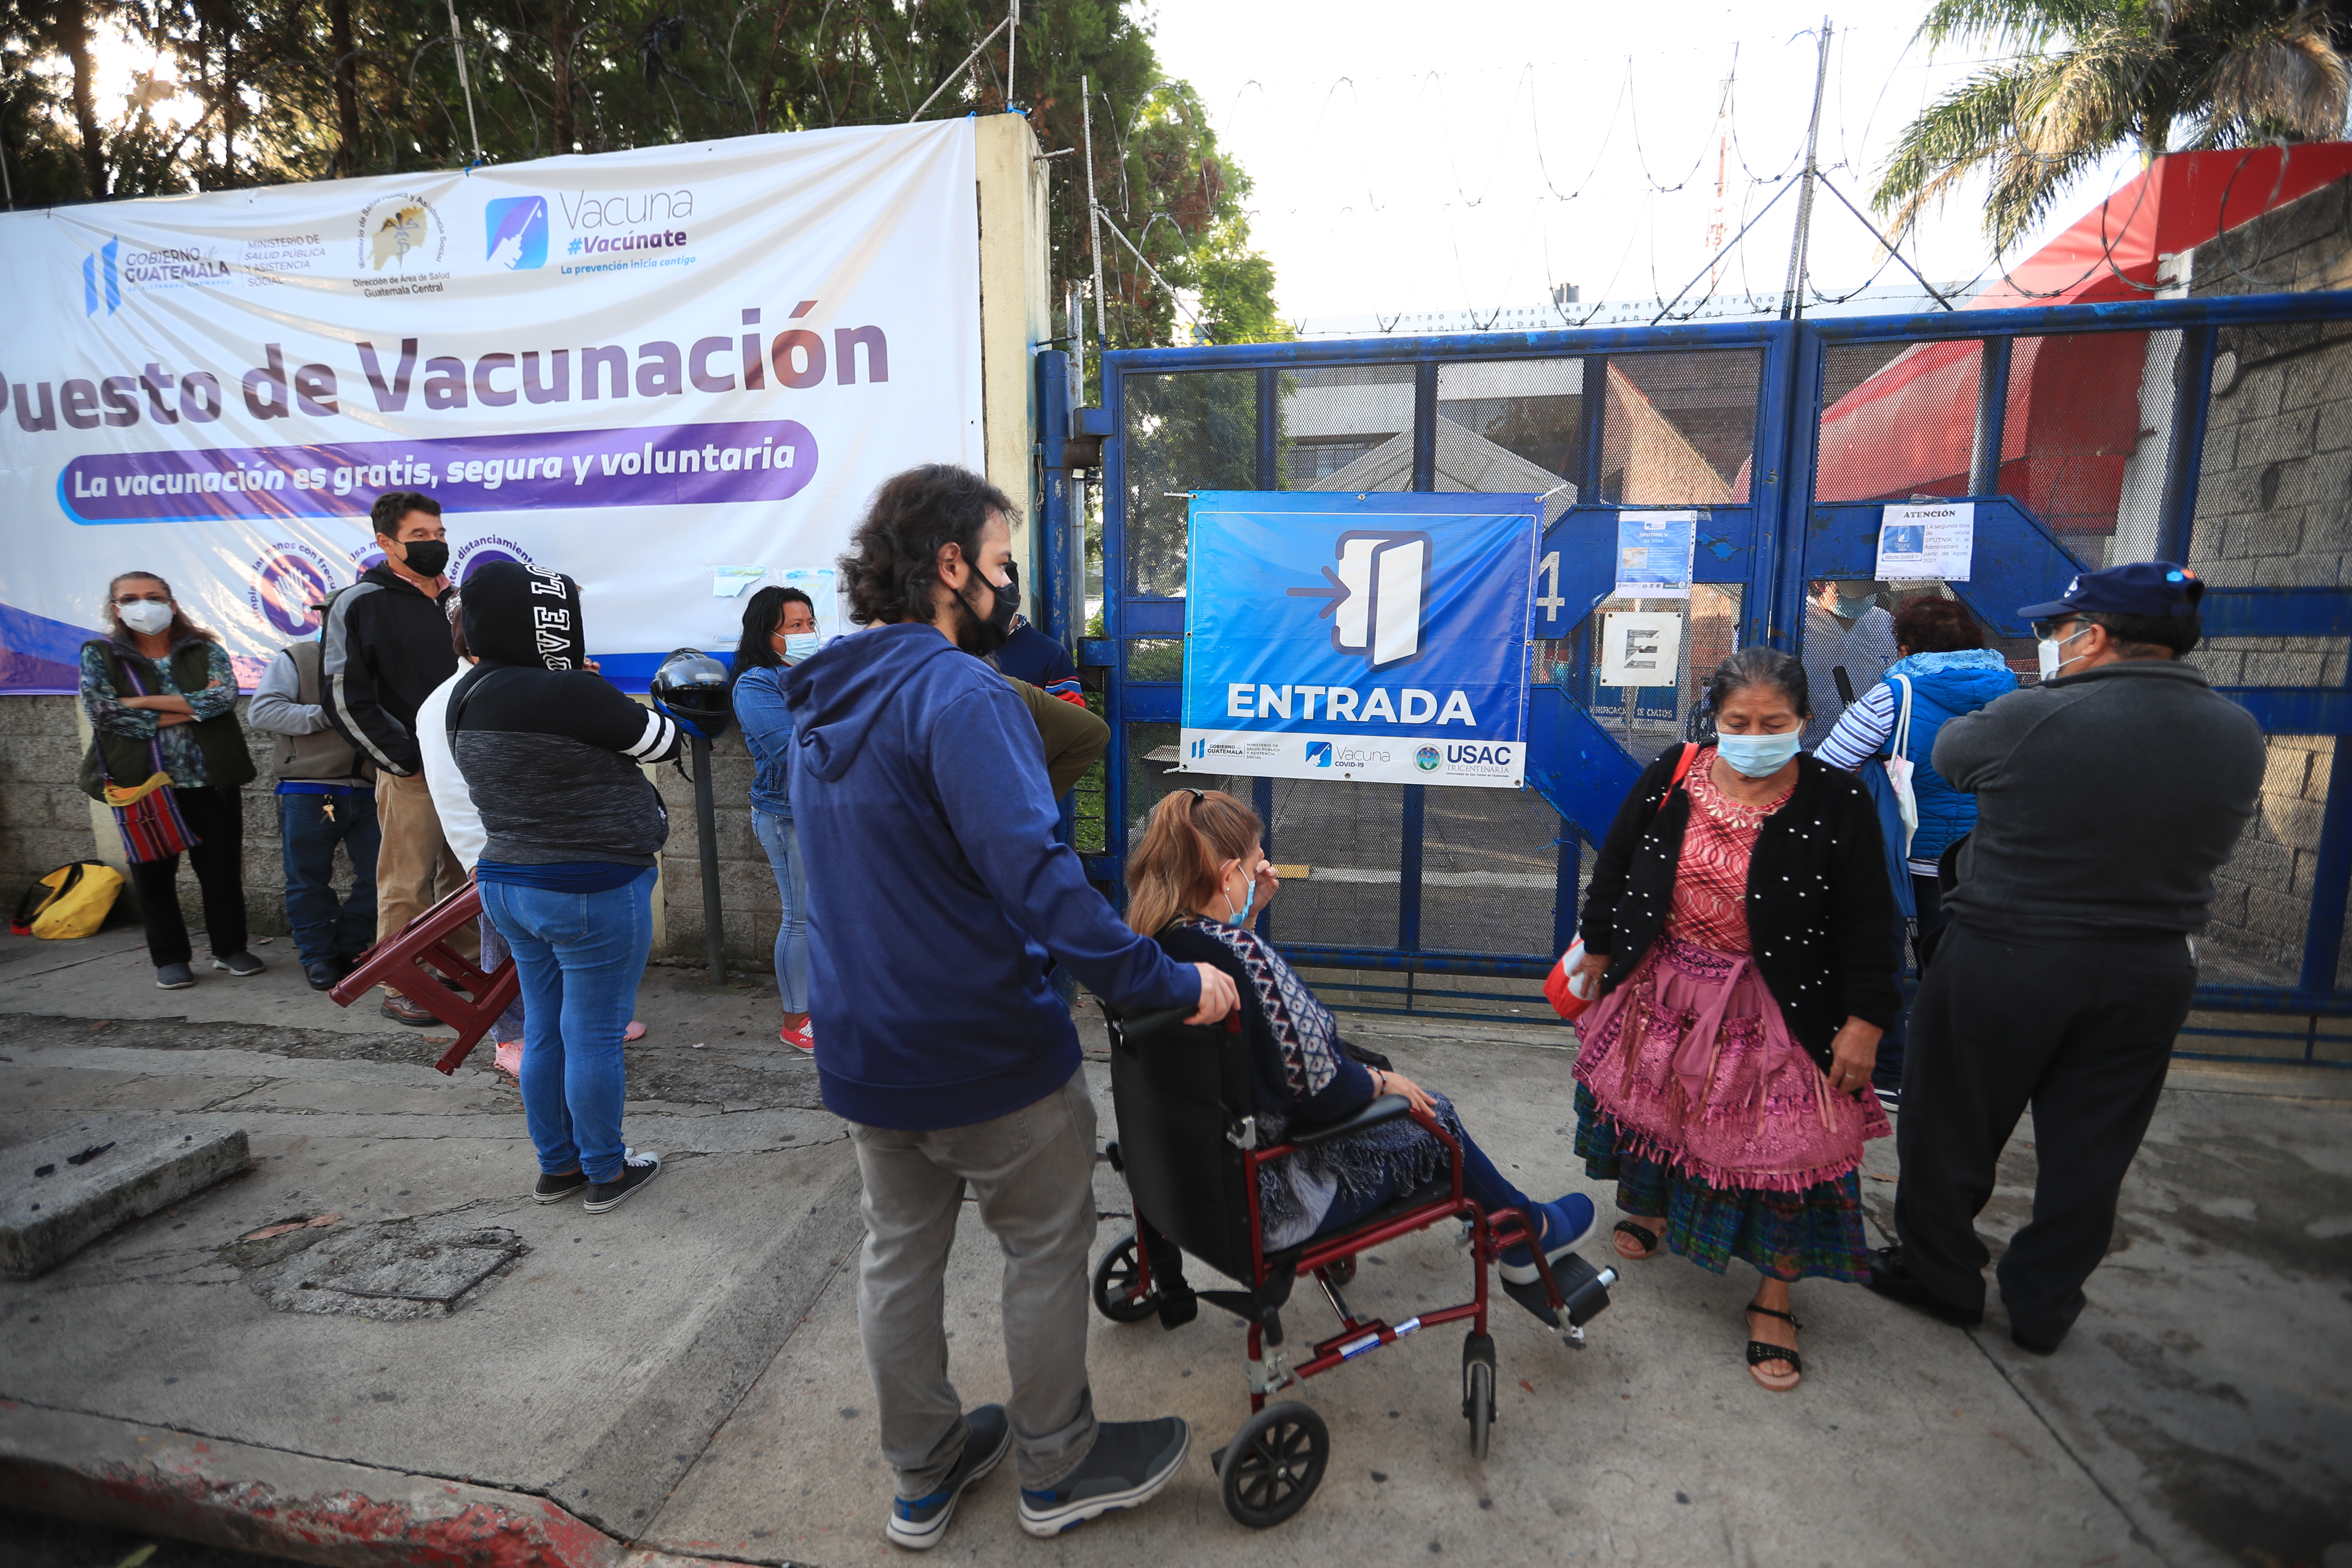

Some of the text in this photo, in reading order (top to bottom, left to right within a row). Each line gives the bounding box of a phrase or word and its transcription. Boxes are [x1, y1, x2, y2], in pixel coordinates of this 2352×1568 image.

[560, 190, 693, 230] Vacuna
[358, 217, 366, 228] de
[410, 194, 415, 202] y
[416, 196, 445, 235] Asistencia
[436, 236, 447, 263] Social
[248, 234, 321, 250] MINISTERIO DE
[567, 229, 687, 254] #Vacúnate
[126, 247, 200, 266] GOBIERNO
[245, 248, 326, 261] SALUD PÚBLICA
[125, 261, 231, 283] GUATEMALA
[253, 260, 311, 273] ASISTENCIA
[561, 256, 696, 276] La prevención inicia contigo
[248, 276, 284, 288] SOCIAL
[352, 272, 451, 288] Dirección de Área de Salud
[364, 282, 444, 298] Guatemala Central
[1622, 296, 1775, 310] METPOLITANO
[0, 300, 889, 433] uesto de Vacunación
[74, 436, 796, 499] La vacunación es gratis, segura y voluntaria
[1903, 509, 1956, 518] ATENCIÓN
[349, 545, 367, 563] Usa
[458, 534, 534, 565] distanciamient
[299, 545, 318, 560] con
[317, 558, 337, 590] frecu
[521, 561, 572, 671] OVE LO
[1624, 628, 1659, 670] E
[1227, 683, 1477, 726] ENTRADA
[1336, 745, 1391, 762] Vacuna
[1447, 745, 1511, 765] USAC
[1446, 764, 1510, 774] TRICENTENARIA
